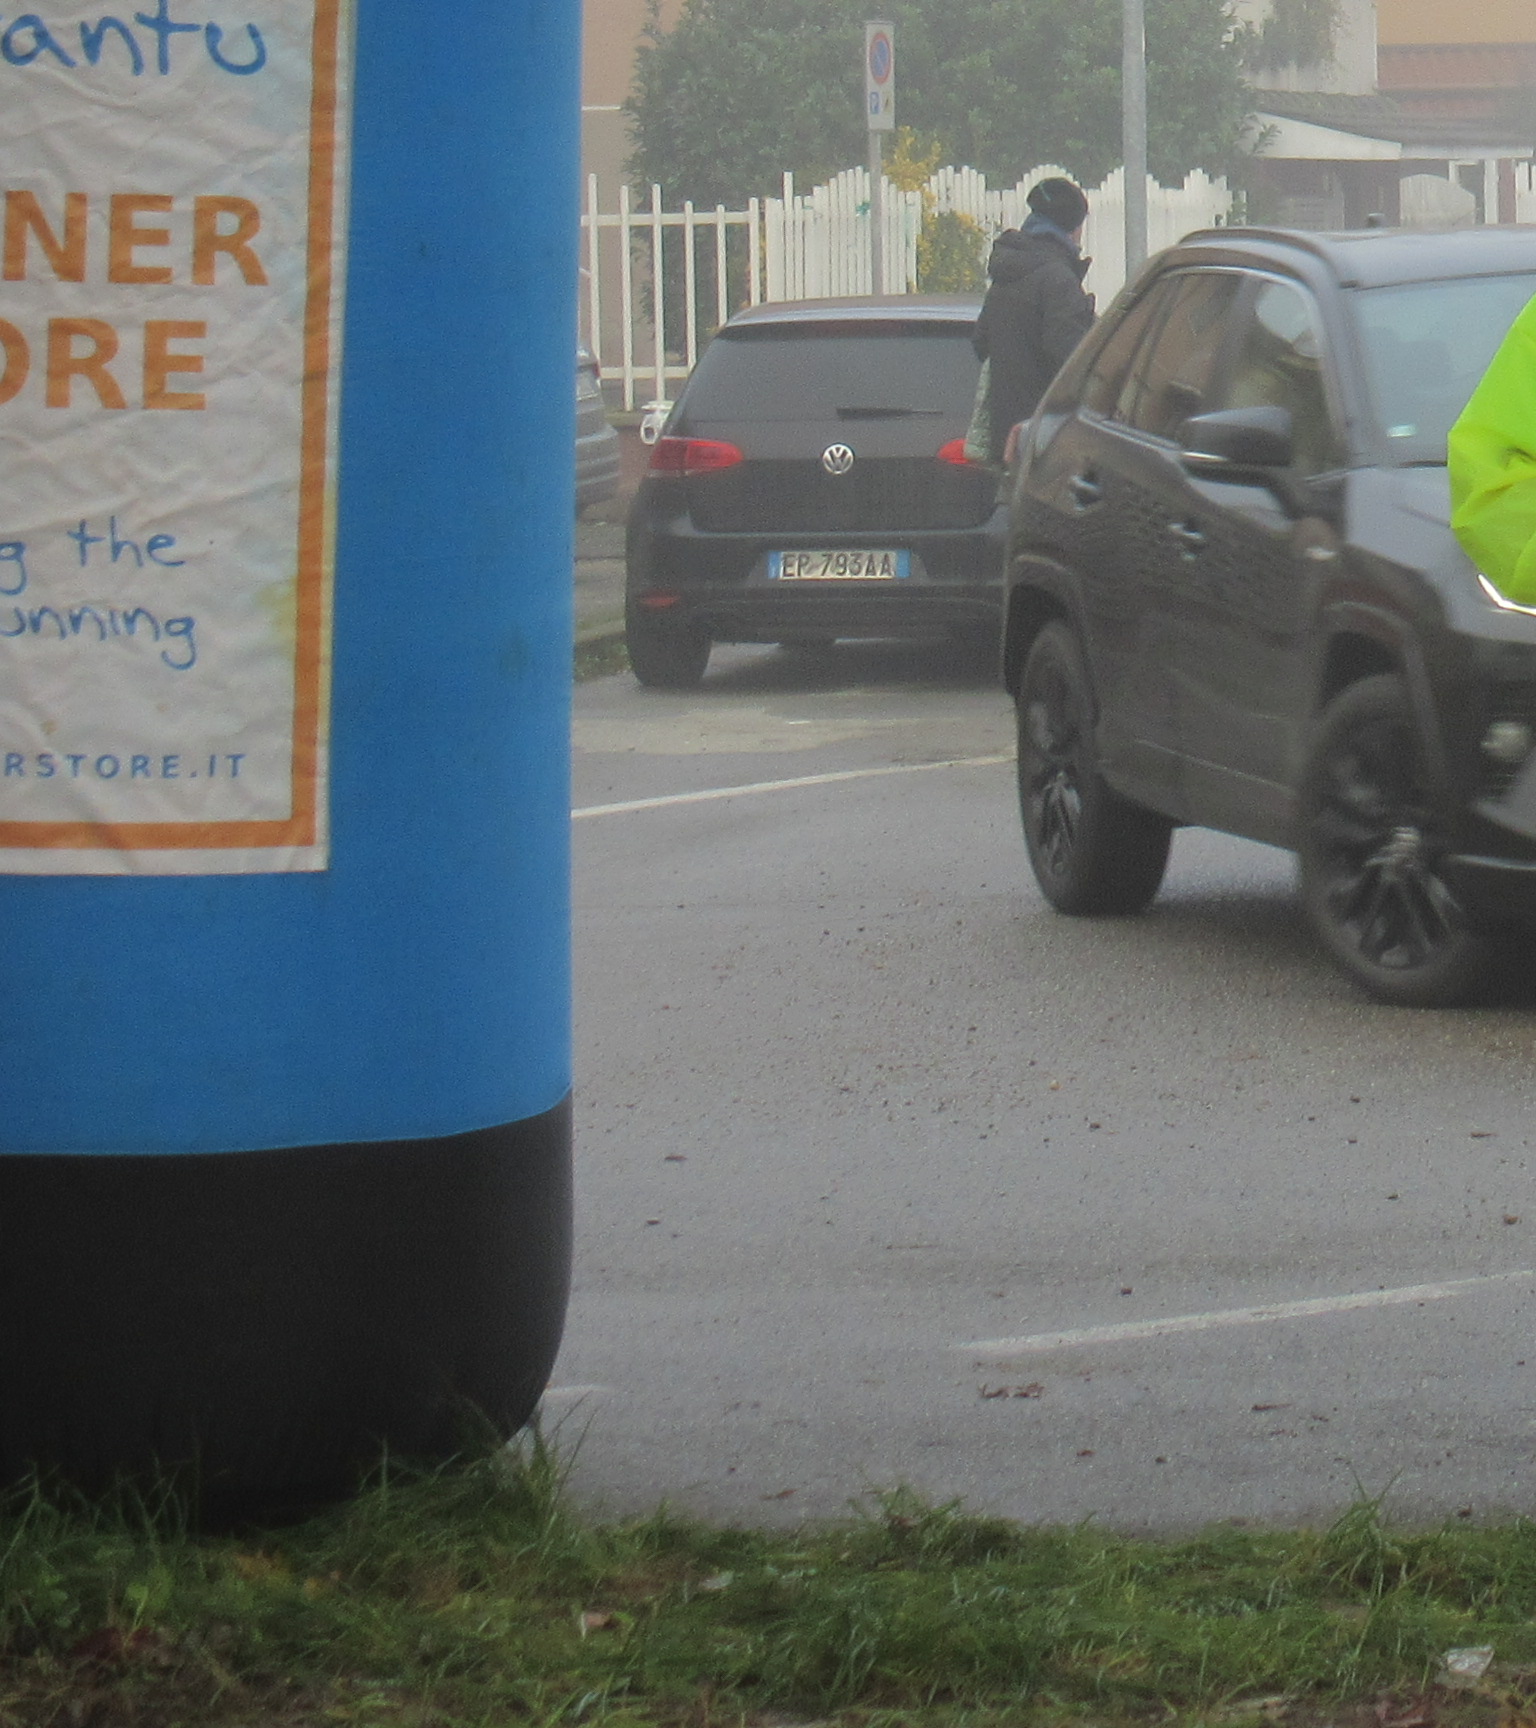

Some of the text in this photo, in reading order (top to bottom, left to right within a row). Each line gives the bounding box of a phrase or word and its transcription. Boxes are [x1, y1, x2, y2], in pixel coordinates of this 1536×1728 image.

[1, 190, 269, 286] NER
[66, 515, 186, 567] the
[4, 752, 247, 779] RSTORE.IT
